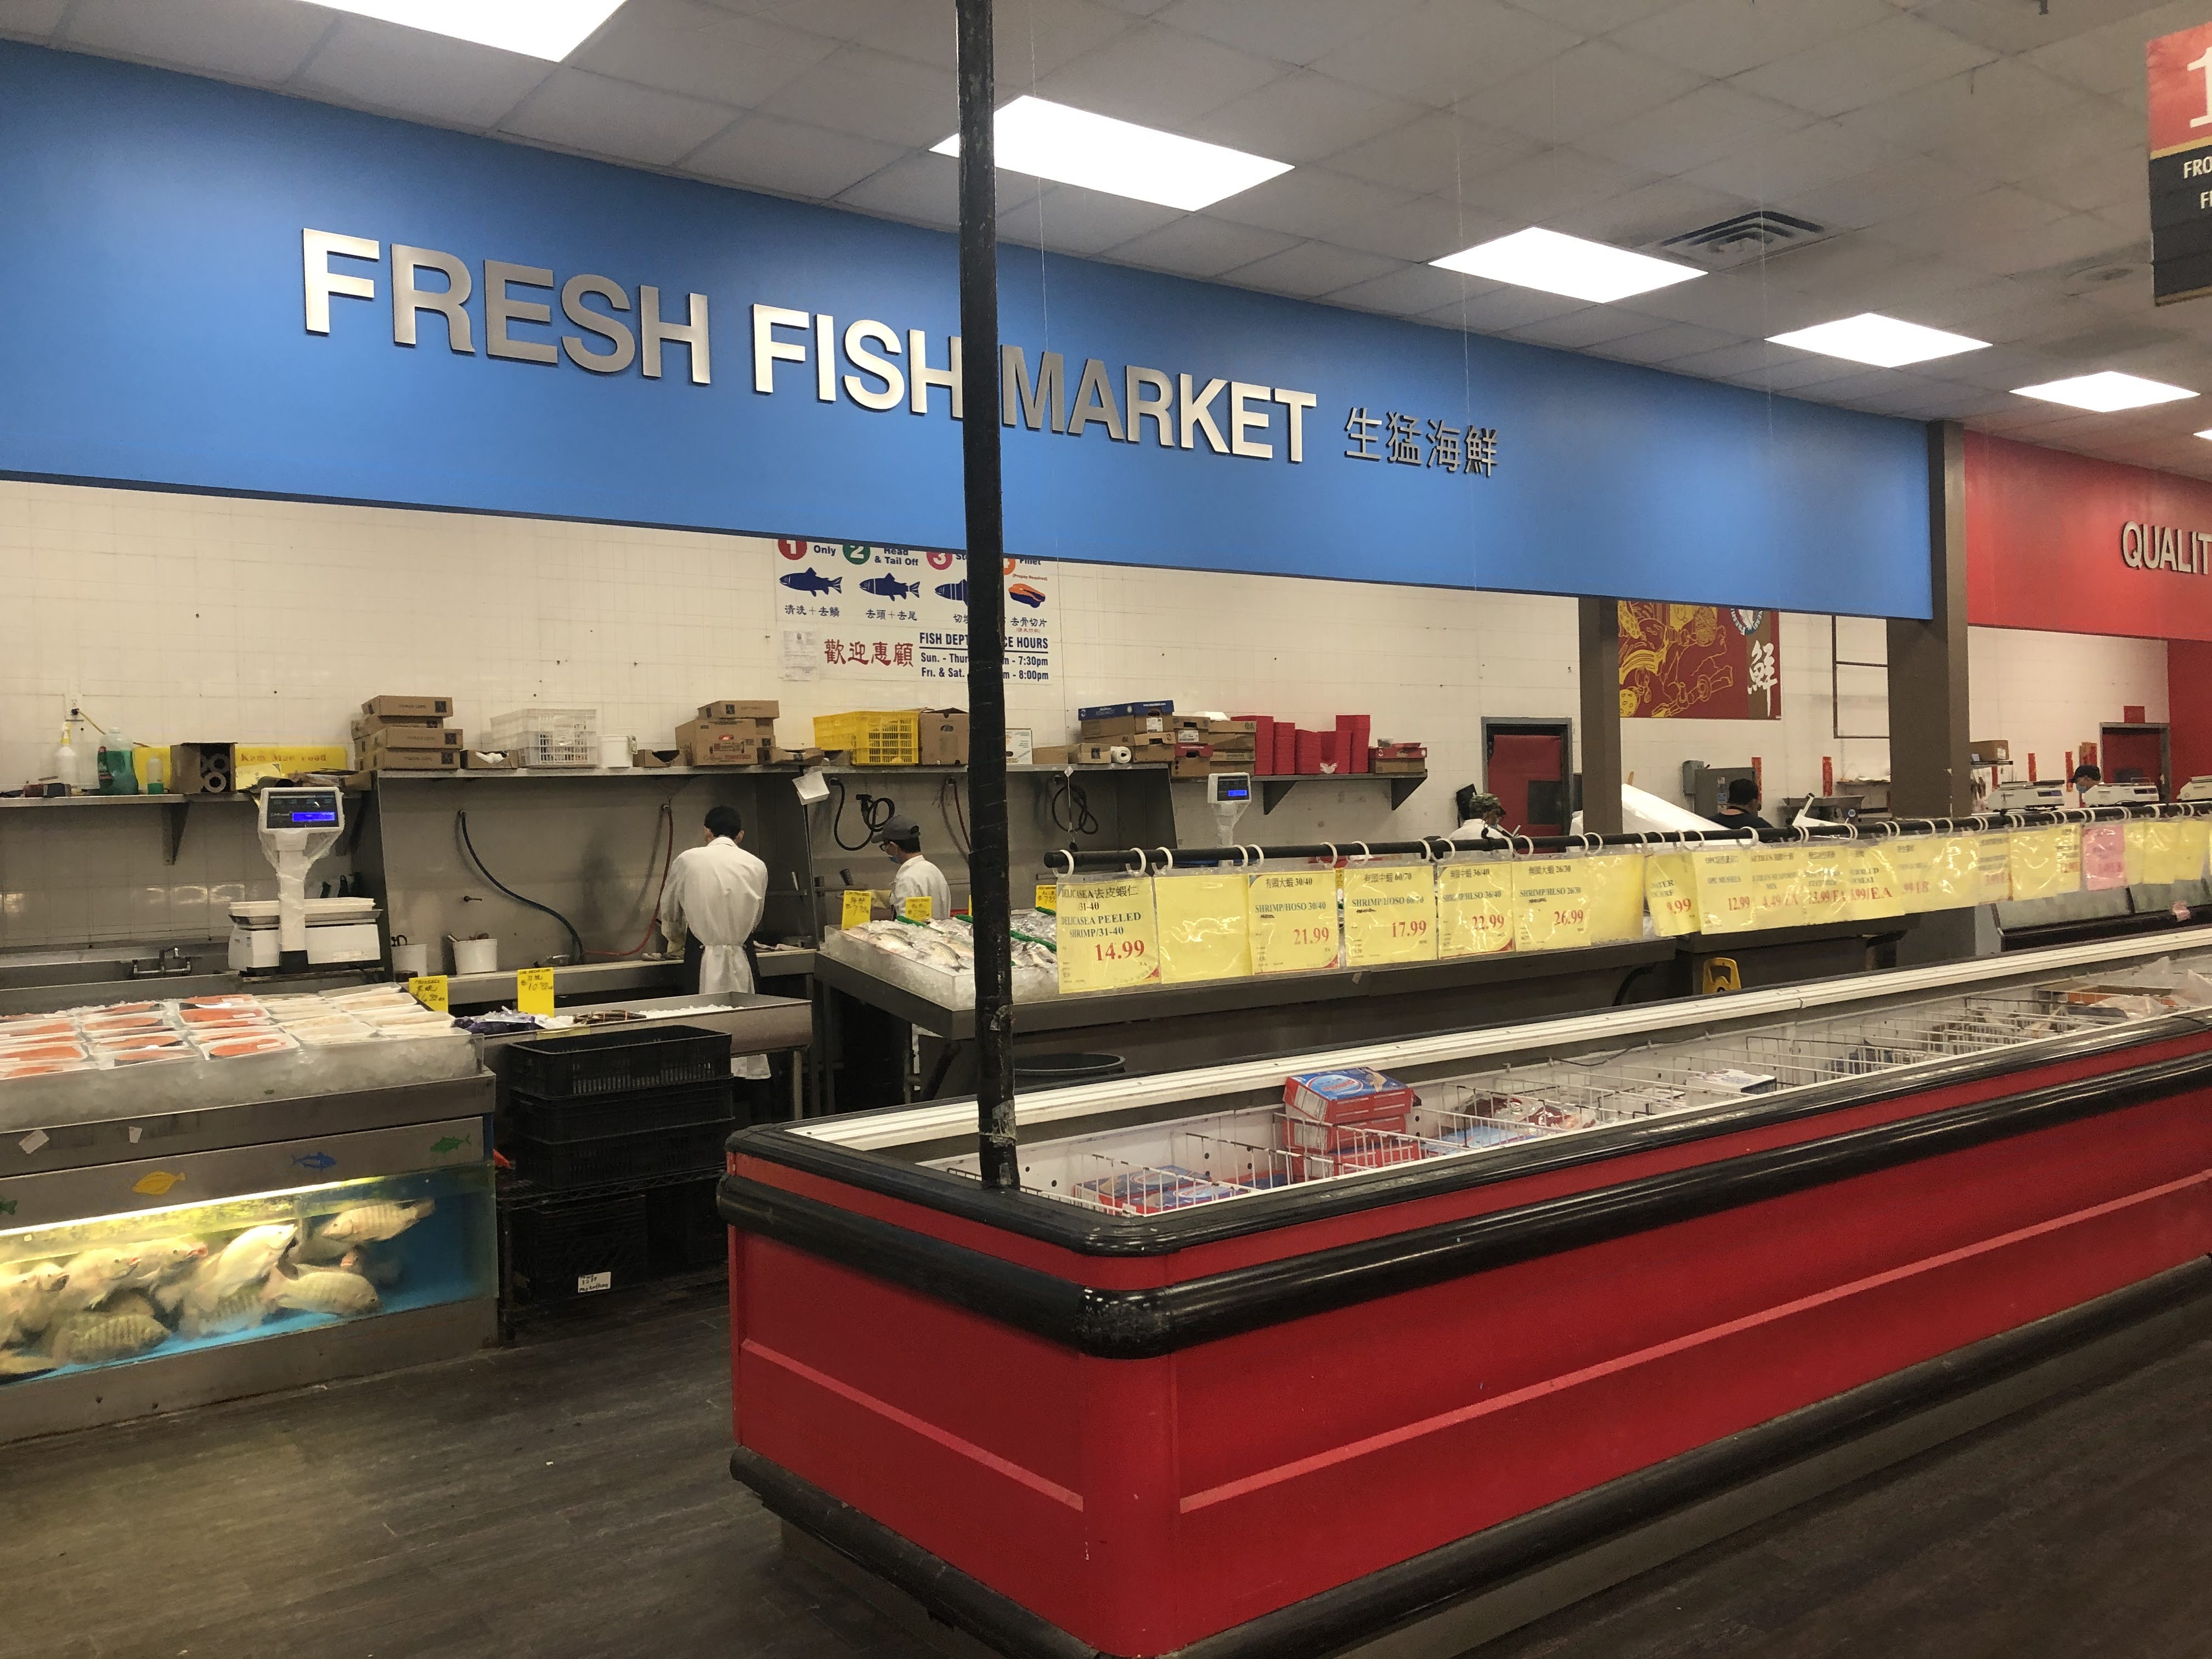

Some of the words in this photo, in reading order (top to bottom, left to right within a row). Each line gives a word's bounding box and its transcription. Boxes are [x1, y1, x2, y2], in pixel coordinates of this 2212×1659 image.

[303, 228, 711, 385] FRESH
[753, 304, 963, 419] FISH
[1000, 343, 1317, 462] MARKET
[1345, 407, 1498, 478] 生猛海鮮
[814, 545, 836, 557] Only
[2122, 521, 2212, 575] QUALIT
[885, 556, 902, 565] Tail
[905, 558, 919, 566] Off
[919, 633, 942, 645] FISH
[1017, 637, 1048, 649] HOURS
[825, 639, 913, 667] 歡迎惠顧
[921, 652, 940, 663] Sun.
[949, 653, 968, 663] Thur
[1018, 656, 1048, 668] 7:30pm
[922, 667, 936, 678] Fri.
[939, 667, 945, 678] &
[948, 668, 965, 678] Sat.
[1019, 670, 1049, 682] 8:00pm
[1295, 878, 1313, 886] 30/40
[1098, 912, 1141, 924] PEELED
[1472, 914, 1504, 930] 22.99
[1554, 909, 1584, 926] 26.99
[1070, 926, 1124, 938] SHRIMP/31-40
[1294, 927, 1329, 945] 21.99
[1392, 920, 1427, 938] 17.99
[1094, 940, 1144, 961] 14.99
